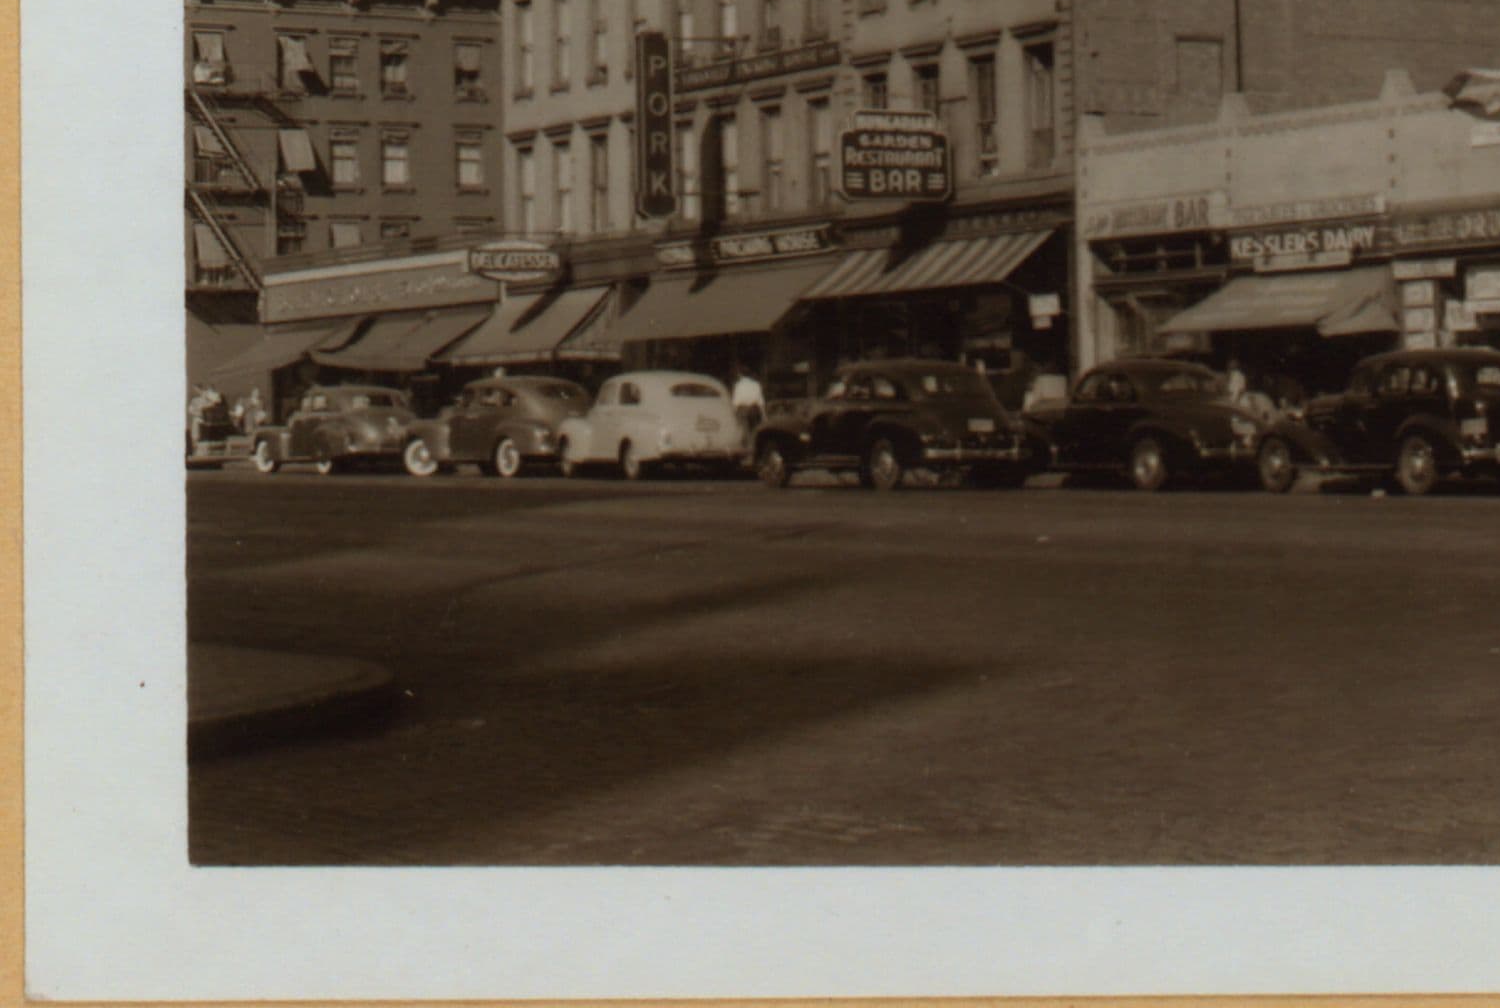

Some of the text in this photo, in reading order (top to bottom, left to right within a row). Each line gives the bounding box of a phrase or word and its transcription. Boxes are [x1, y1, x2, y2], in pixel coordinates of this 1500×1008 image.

[650, 55, 668, 193] PORK
[859, 134, 932, 148] GARDEN
[845, 147, 944, 167] RESTAURANT
[869, 169, 921, 192] BAR
[1322, 225, 1376, 250] DAIRY
